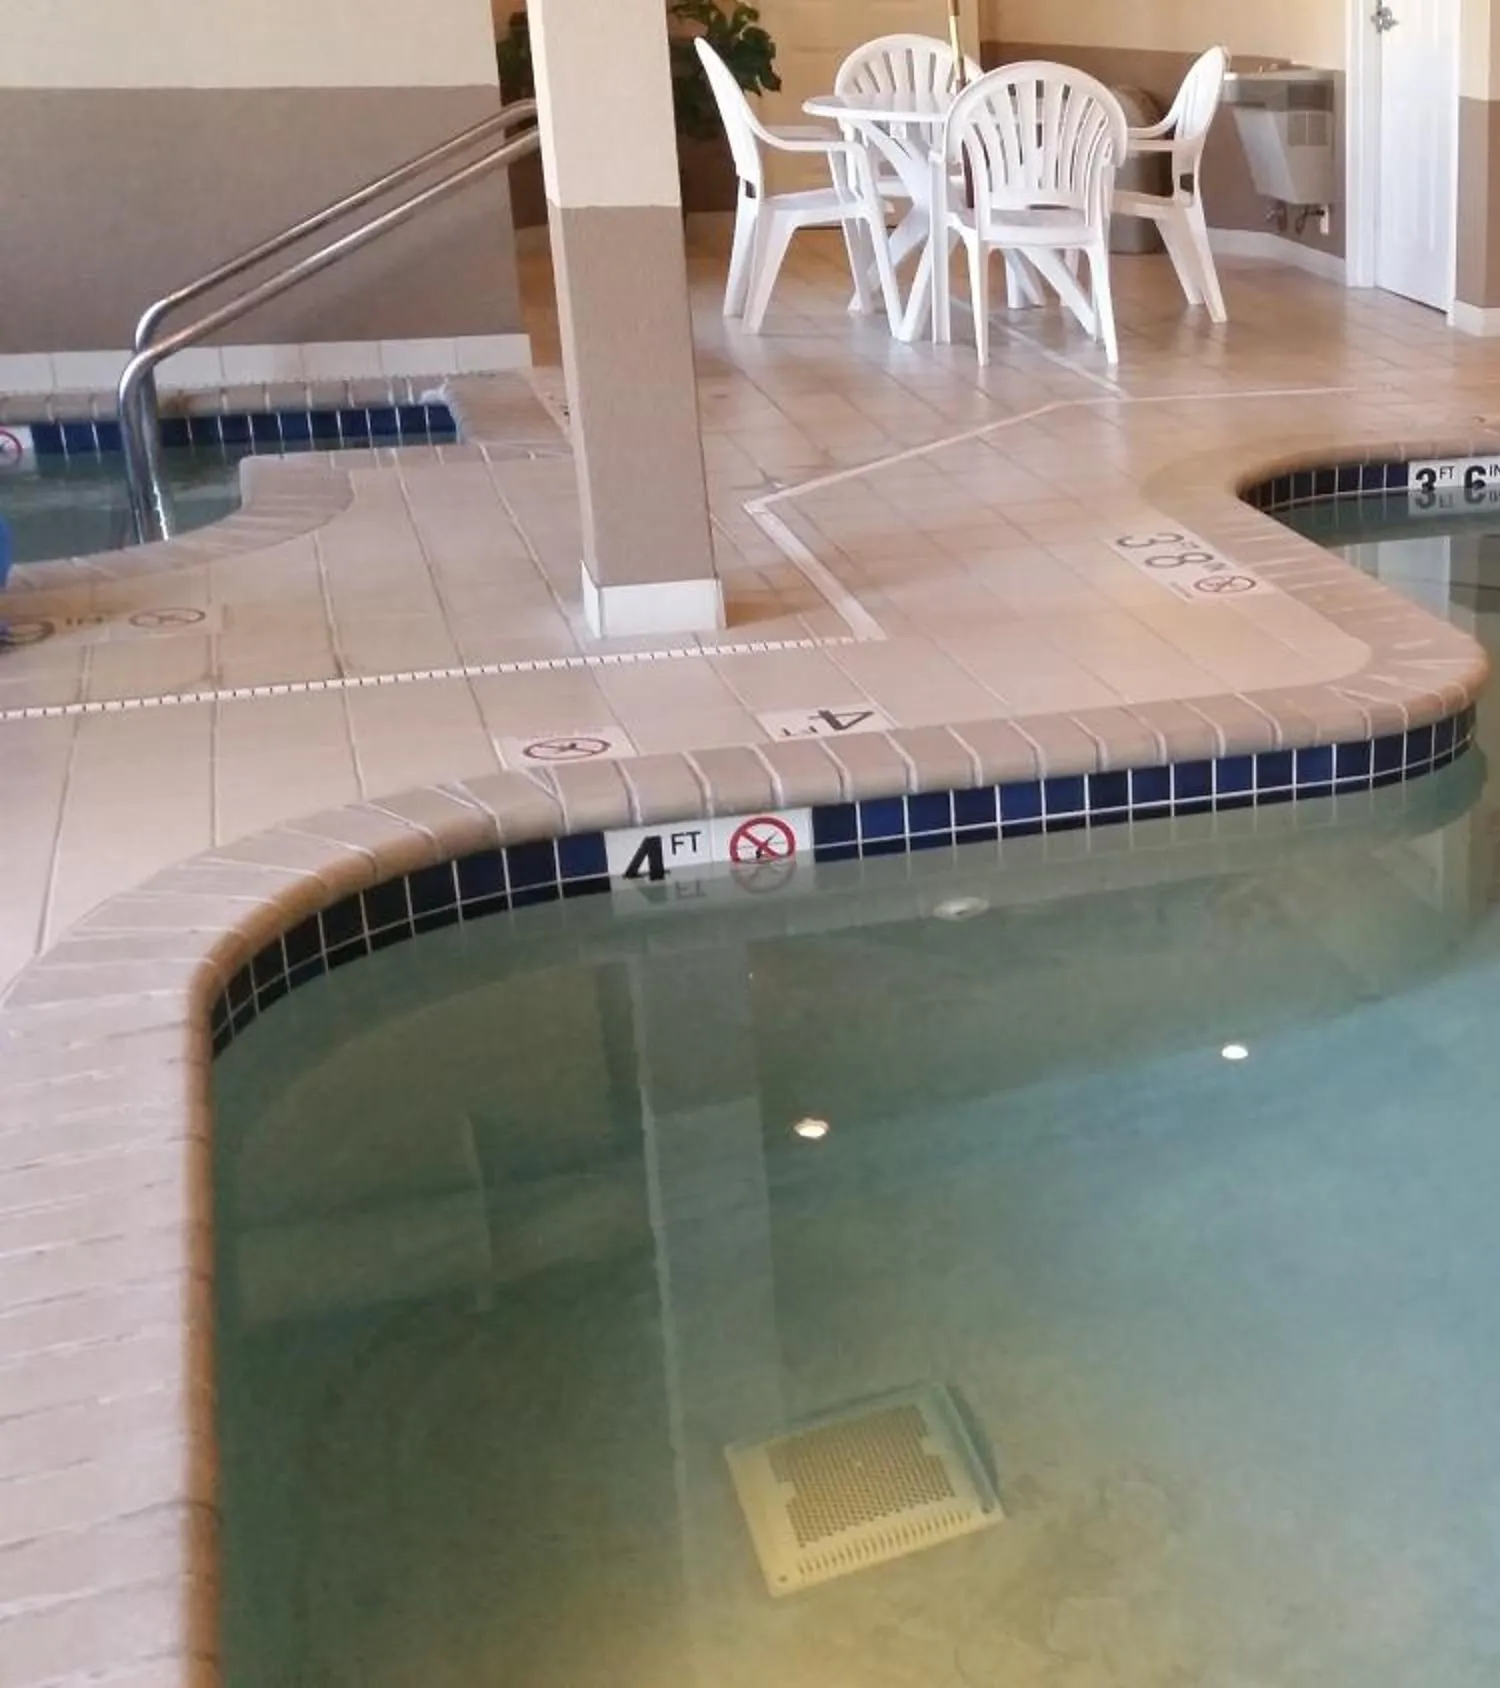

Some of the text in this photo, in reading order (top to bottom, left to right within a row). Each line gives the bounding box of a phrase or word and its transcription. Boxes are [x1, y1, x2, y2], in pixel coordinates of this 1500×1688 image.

[1415, 467, 1437, 493] 3
[1439, 465, 1455, 479] FT
[623, 831, 701, 880] 4 FT
